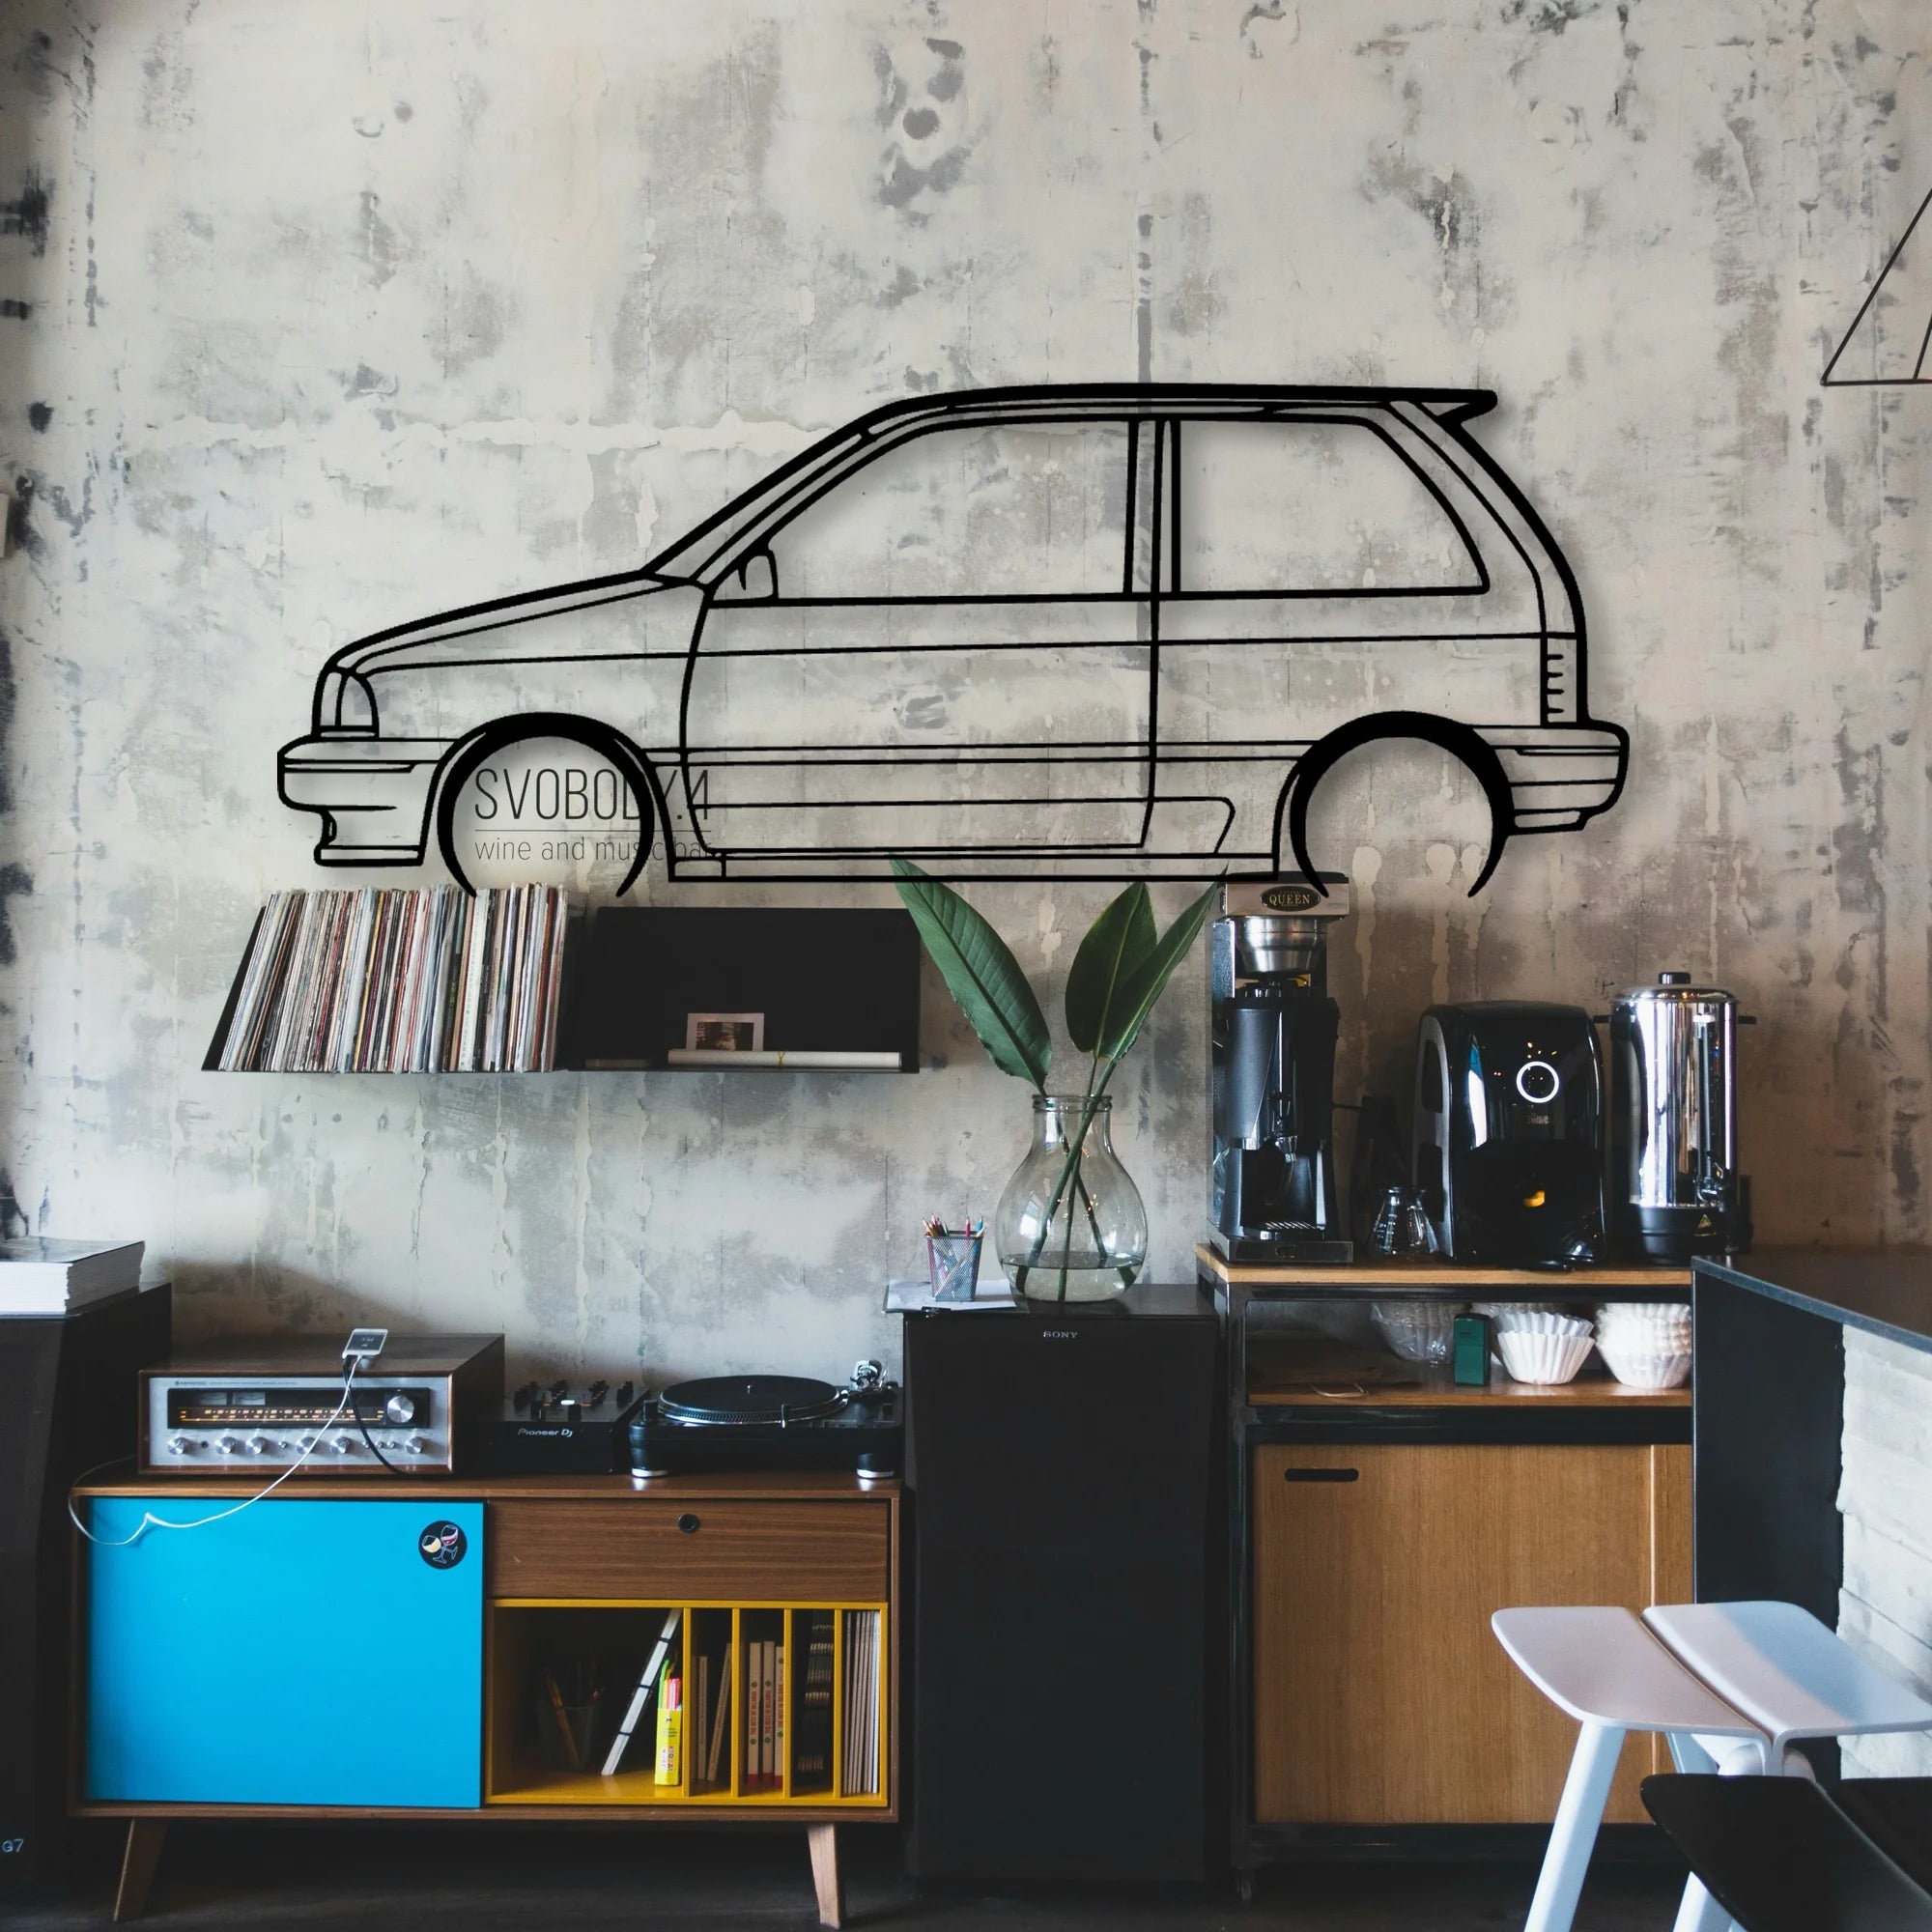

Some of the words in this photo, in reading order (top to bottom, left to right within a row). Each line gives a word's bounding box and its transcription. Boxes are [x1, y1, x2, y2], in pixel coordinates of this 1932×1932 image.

[474, 768, 709, 820] SVOBO.4
[475, 837, 531, 861] wine
[541, 837, 584, 861] and
[595, 840, 664, 861] muc
[1268, 894, 1310, 905] QUEEN
[1043, 1330, 1078, 1339] SONY
[2, 1838, 24, 1853] G7
